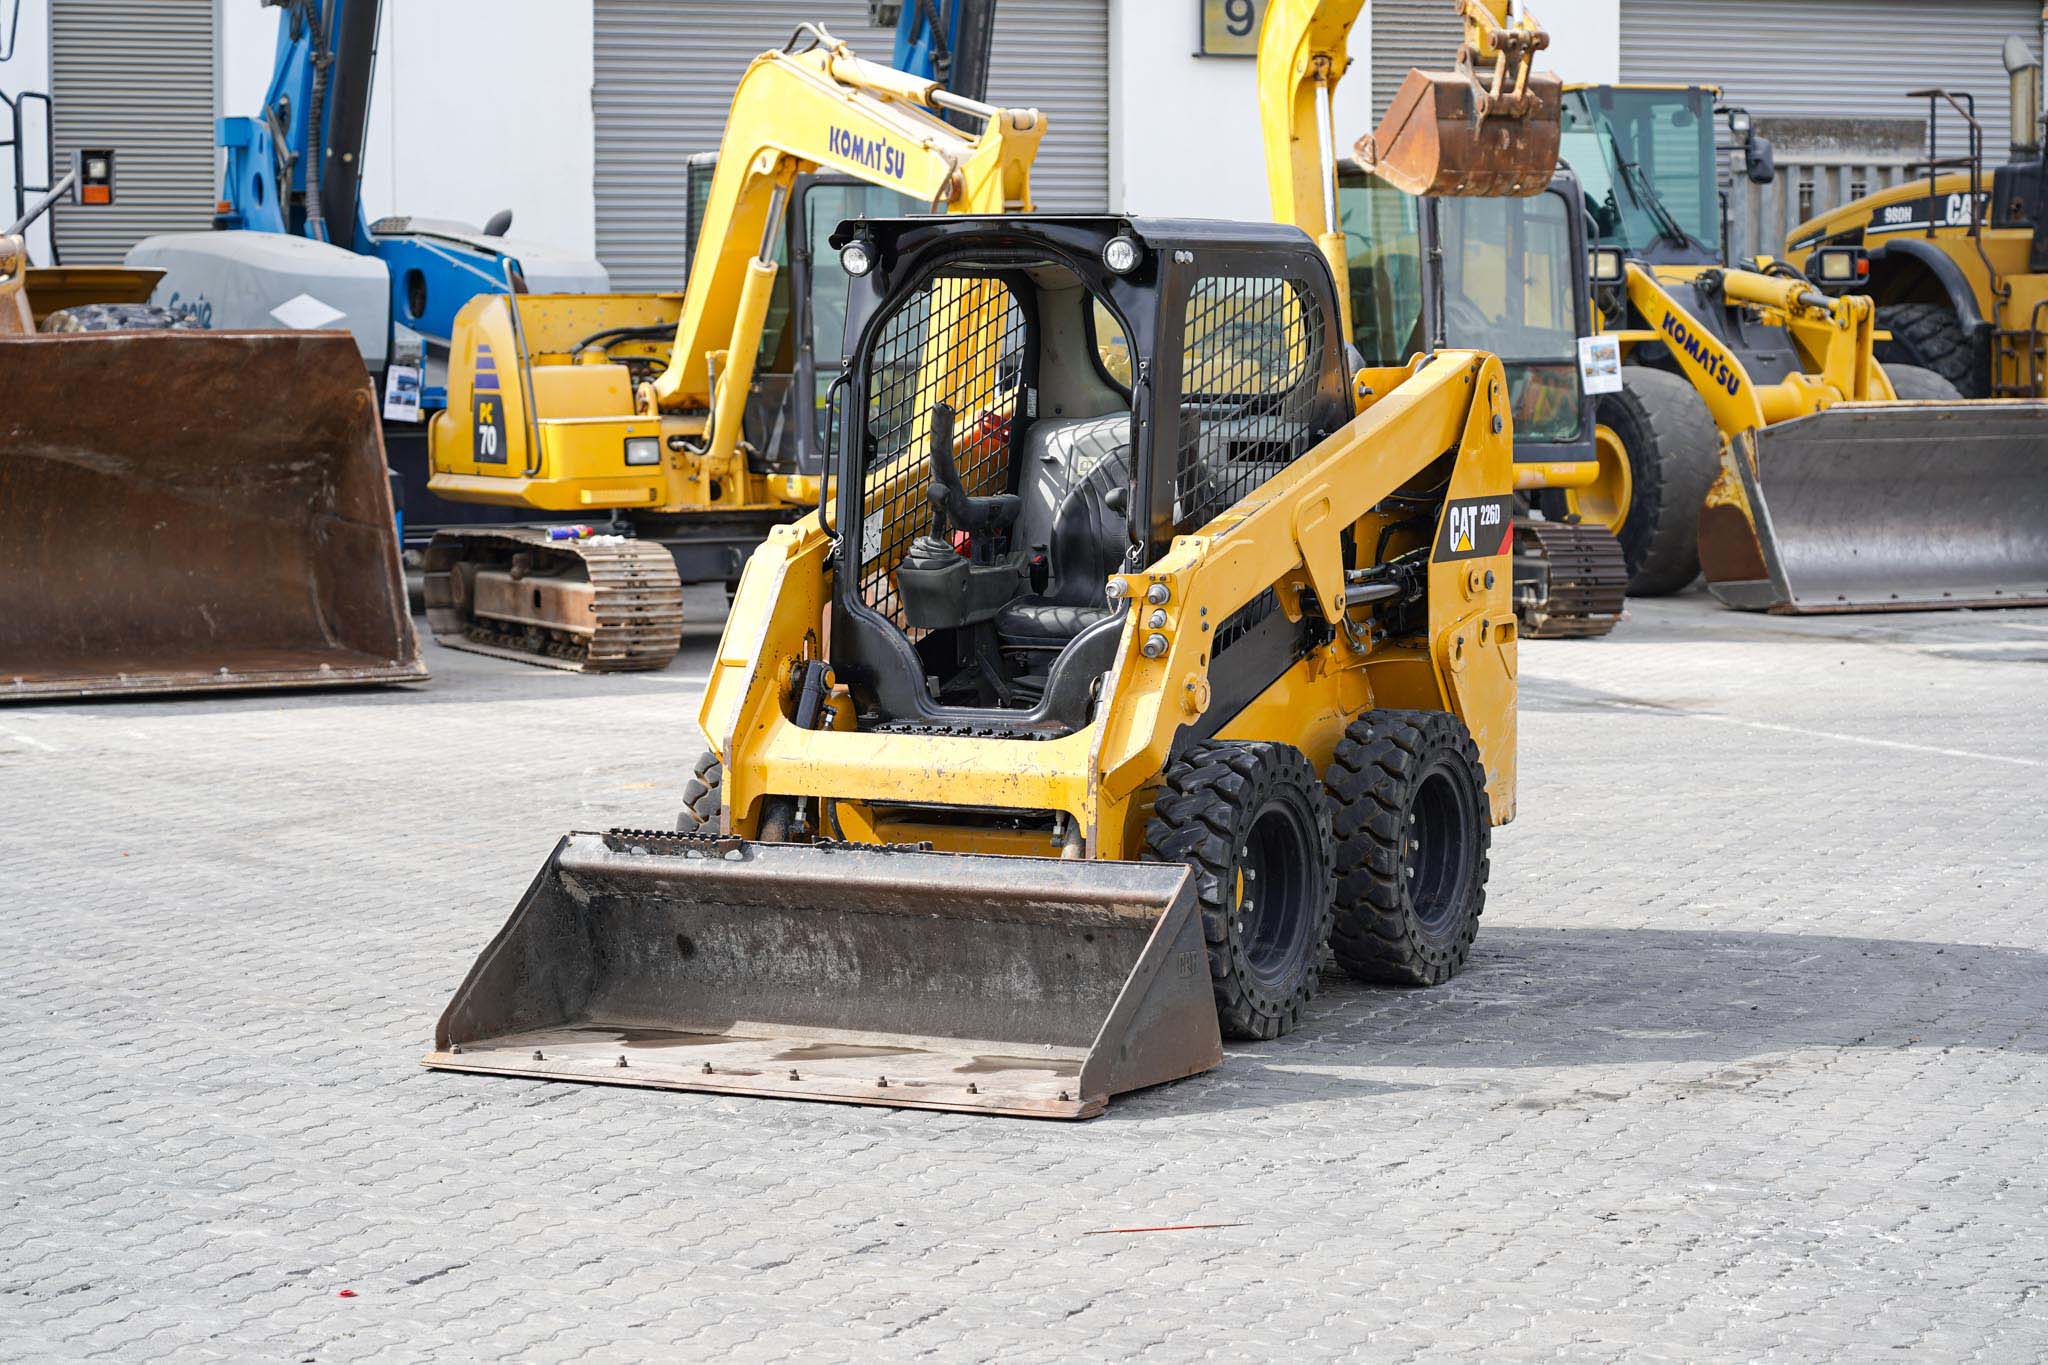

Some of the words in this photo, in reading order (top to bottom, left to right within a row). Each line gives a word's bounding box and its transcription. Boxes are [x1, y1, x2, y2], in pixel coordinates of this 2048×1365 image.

[1226, 0, 1254, 36] 9
[829, 125, 905, 179] KOMATSU
[1662, 310, 1740, 396] KOMATSU
[479, 402, 493, 424] PC
[479, 425, 497, 455] 70
[1450, 506, 1478, 552] CAT
[1480, 503, 1501, 526] 226D
